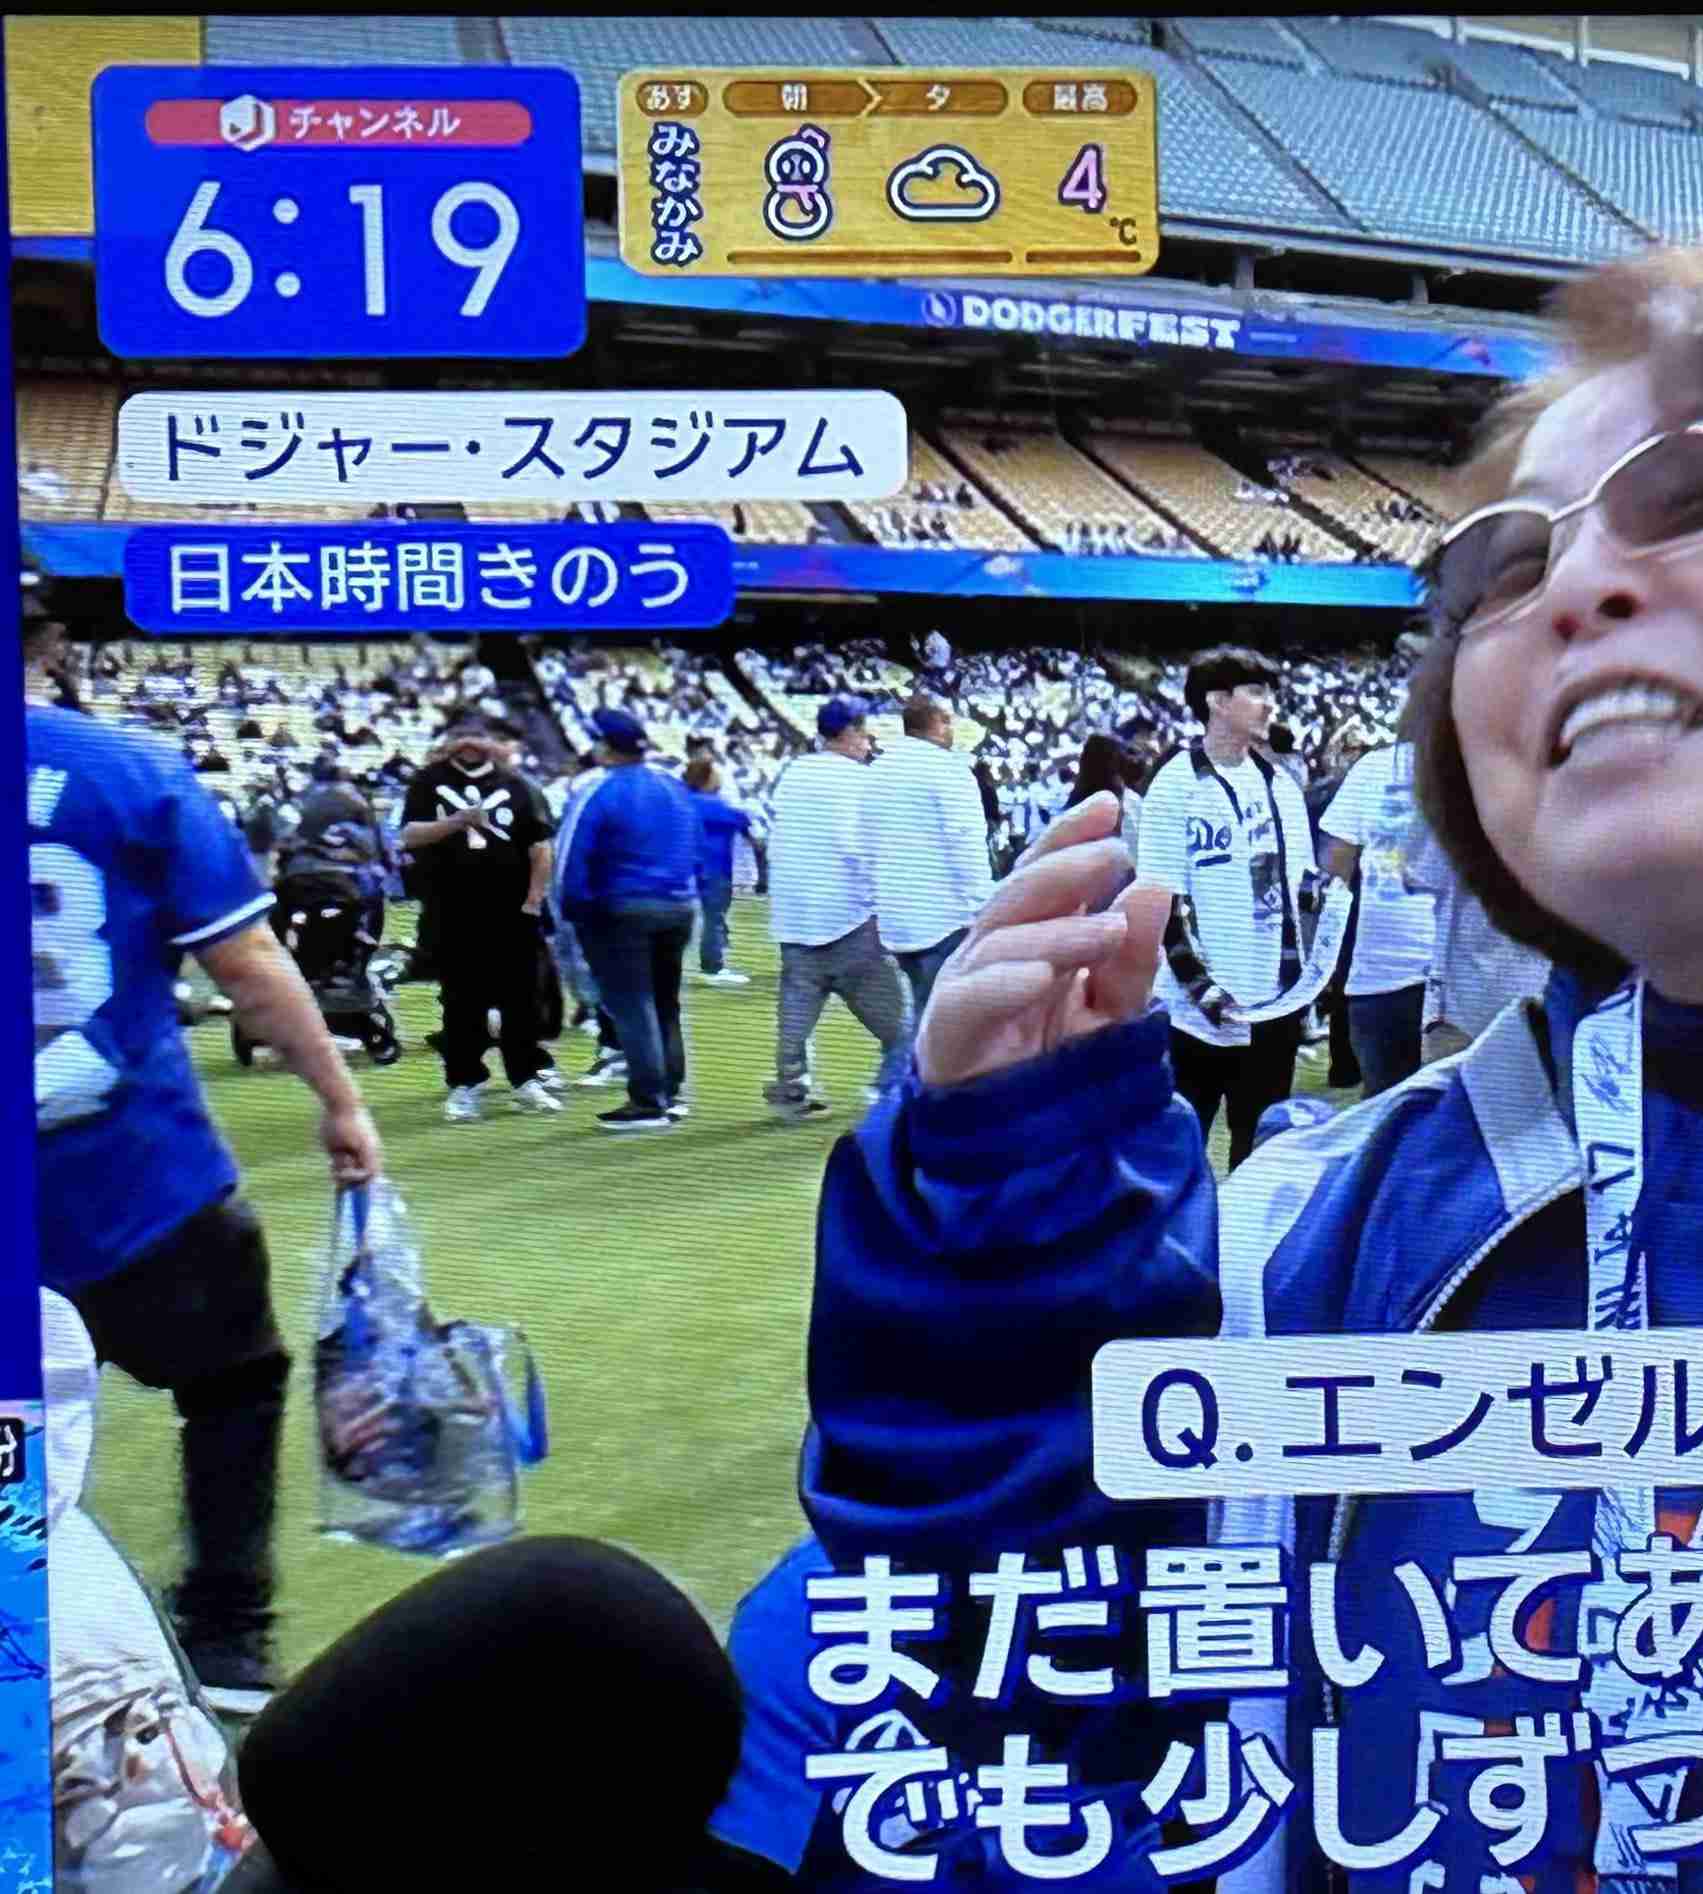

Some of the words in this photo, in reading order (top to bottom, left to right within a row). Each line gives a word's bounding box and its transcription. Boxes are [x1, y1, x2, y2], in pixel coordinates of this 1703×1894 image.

[289, 106, 462, 140] チャンネル
[645, 84, 693, 111] あす
[781, 84, 808, 111] 朝
[1053, 84, 1108, 112] 最高
[650, 124, 699, 264] みなかみ
[1060, 145, 1105, 211] 4
[164, 180, 521, 318] 6:19
[962, 295, 1241, 350] DODGERFEST
[166, 411, 864, 484] ドジャー・スタジアム
[170, 541, 691, 614] 日本時間きのう
